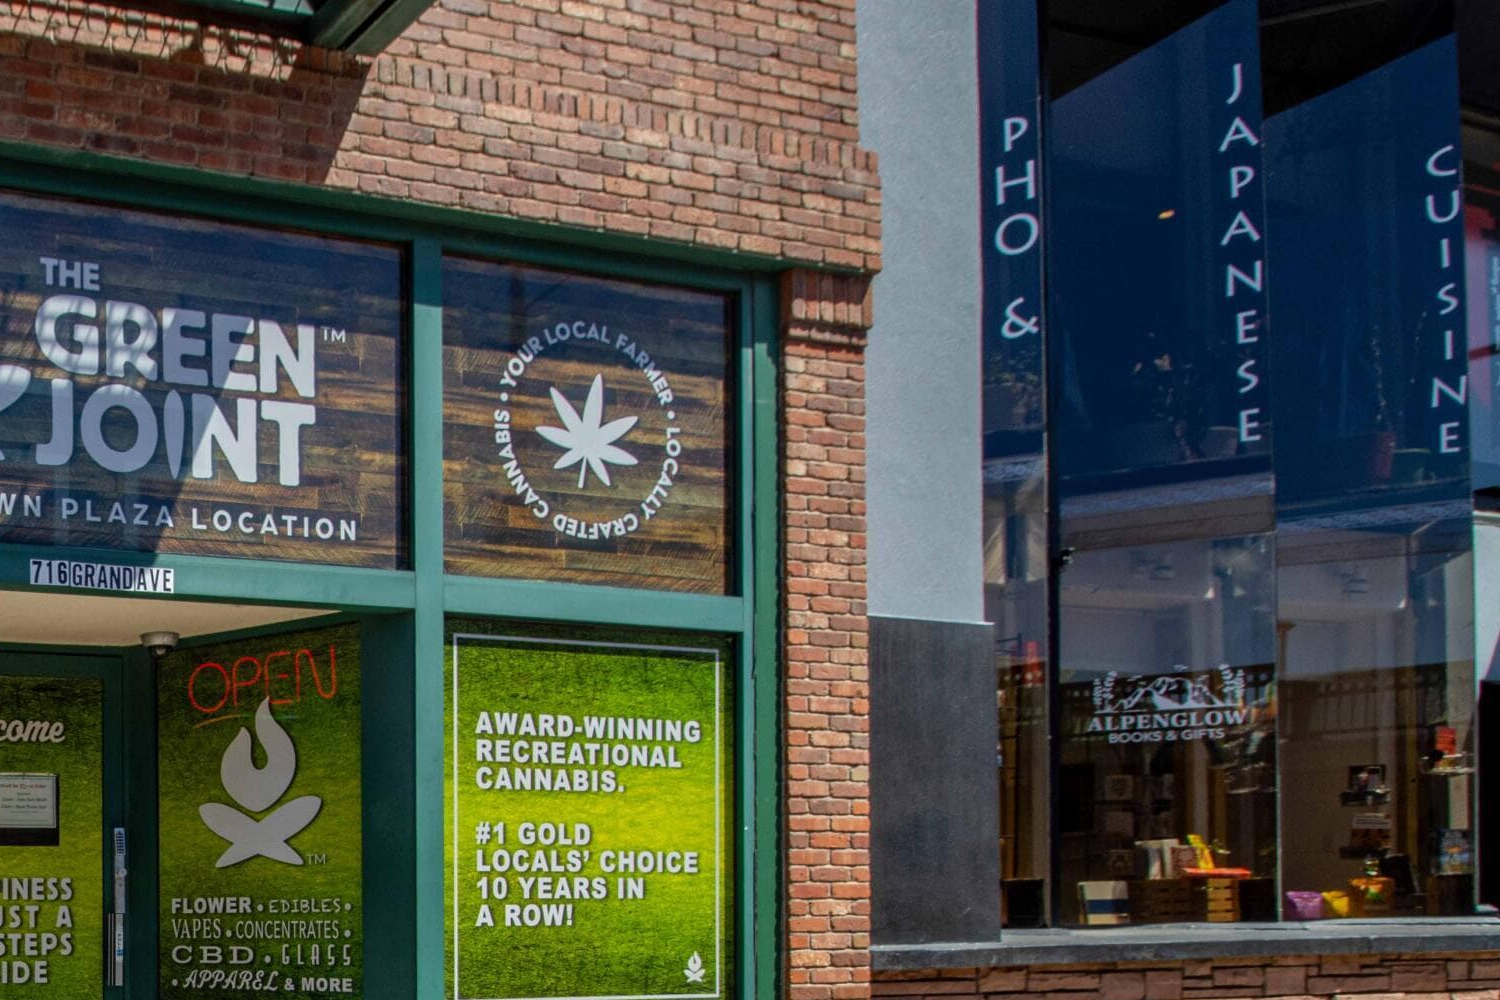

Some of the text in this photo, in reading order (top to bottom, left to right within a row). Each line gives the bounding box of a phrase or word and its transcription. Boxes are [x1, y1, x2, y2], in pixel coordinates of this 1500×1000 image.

[994, 117, 1039, 340] PHO &
[1218, 63, 1263, 443] JAPANESE
[40, 257, 100, 291] THE
[1425, 144, 1467, 454] CUISINE
[35, 294, 346, 399] GREEN TM
[500, 321, 675, 407] YOUR LOCAL FARMER
[35, 378, 316, 487] JOINT
[494, 408, 682, 540] LOCALLY CRAFTED CANNABIS
[61, 498, 175, 529] PLAZA
[191, 508, 358, 541] LOCATION
[188, 645, 337, 714] OPEN
[475, 711, 701, 743] AWARD-WINNING
[1087, 710, 1247, 732] ALPENGLOW
[1108, 728, 1226, 744] BOOKS & GIFTS
[476, 739, 682, 768] RECREATIONAL
[475, 766, 625, 793] CANNABIS.
[475, 822, 592, 845] #1 GOLD
[600, 851, 699, 873] CHOICE
[477, 877, 645, 899] 10 YEARS IN
[56, 905, 74, 929] A
[171, 897, 341, 914] FLOWER EDIBLES
[475, 903, 574, 927] A ROW!
[172, 918, 340, 939] VAPES CONCENTRATES
[171, 943, 352, 966] CBD GLASS
[183, 970, 353, 993] APPAREL & MORE
